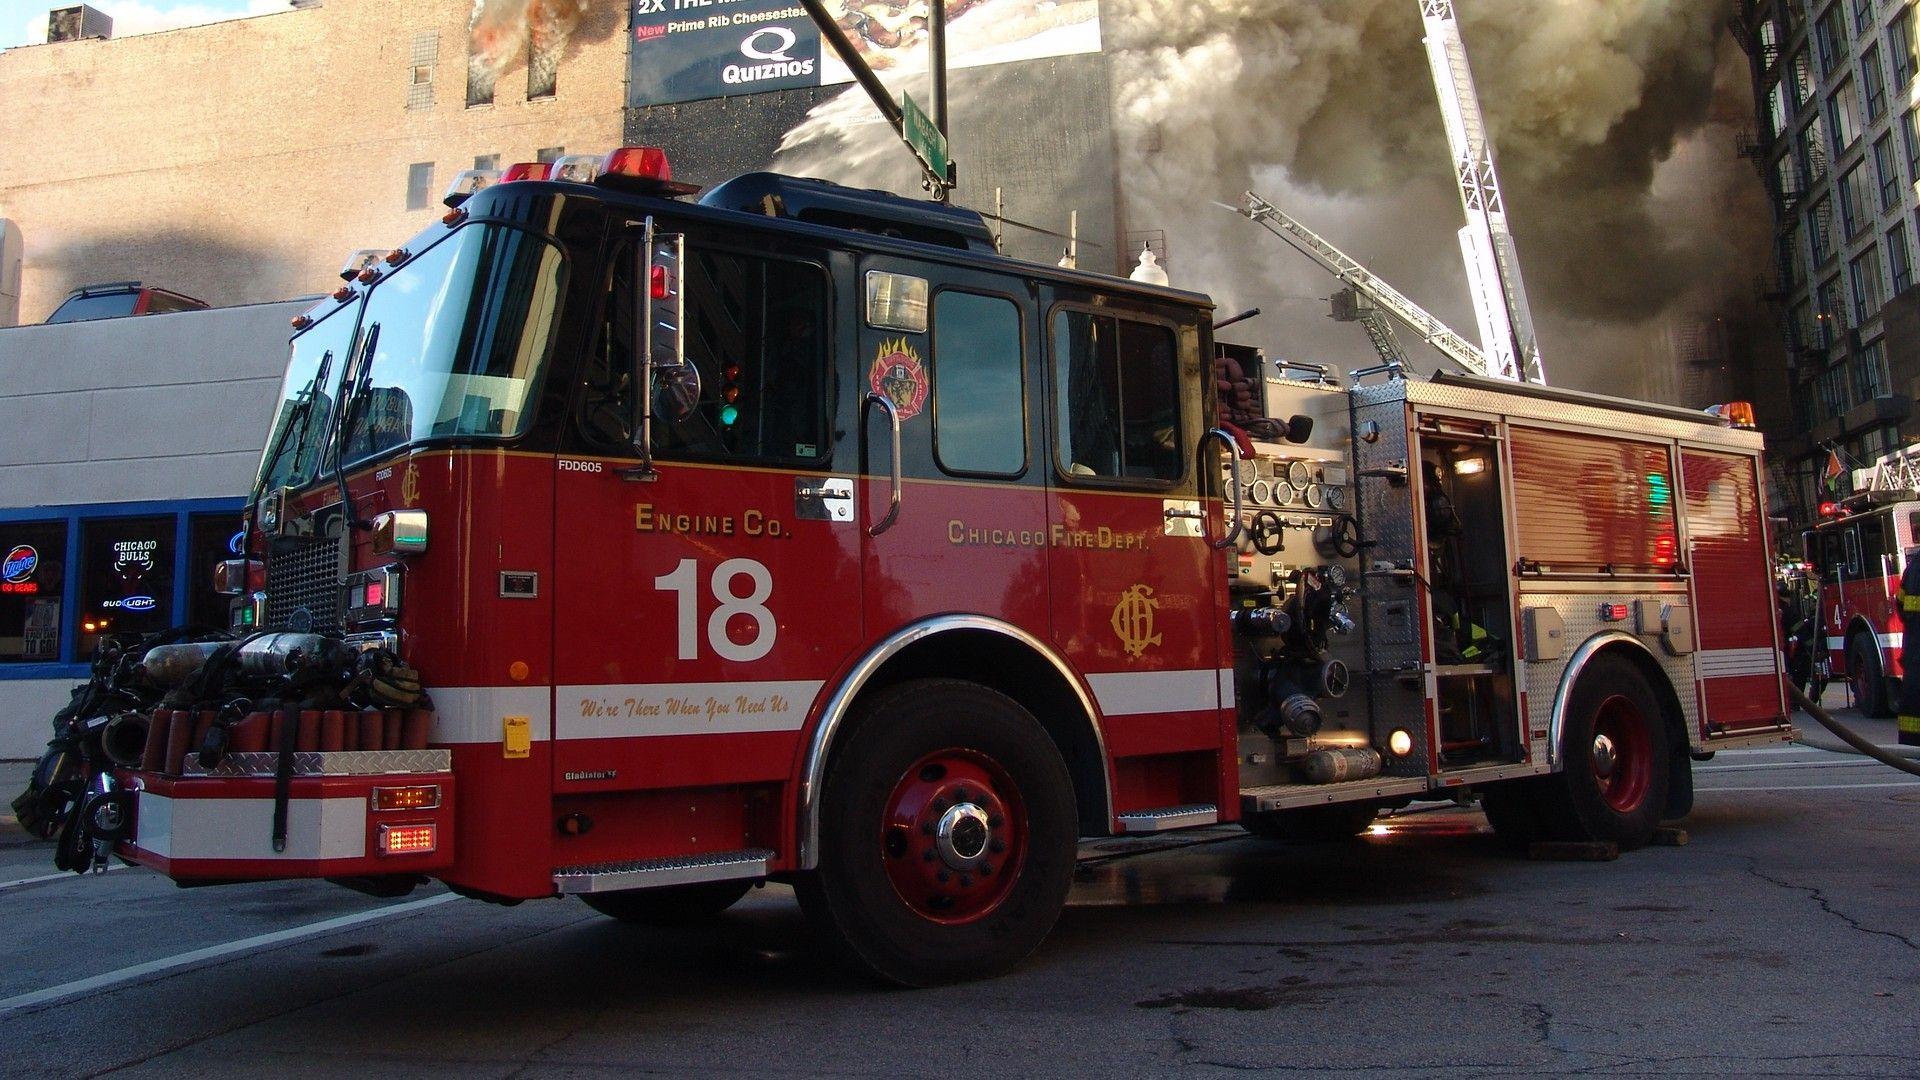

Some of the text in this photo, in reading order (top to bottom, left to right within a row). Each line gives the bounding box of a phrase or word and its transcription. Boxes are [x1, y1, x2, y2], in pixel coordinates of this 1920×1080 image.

[638, 0, 667, 14] 2X
[637, 6, 809, 38] New Prime Rib Cheesestea
[722, 59, 815, 84] Quiznos
[558, 460, 602, 472] FDD605
[635, 503, 791, 537] ENGINE CO.
[114, 541, 157, 551] CHICAGO
[948, 520, 1149, 550] CHICAGO FIRE DEPT.
[120, 551, 150, 561] BULLS
[654, 557, 777, 662] 18
[1834, 604, 1841, 630] 4
[580, 694, 789, 722] We're There When You Need Us
